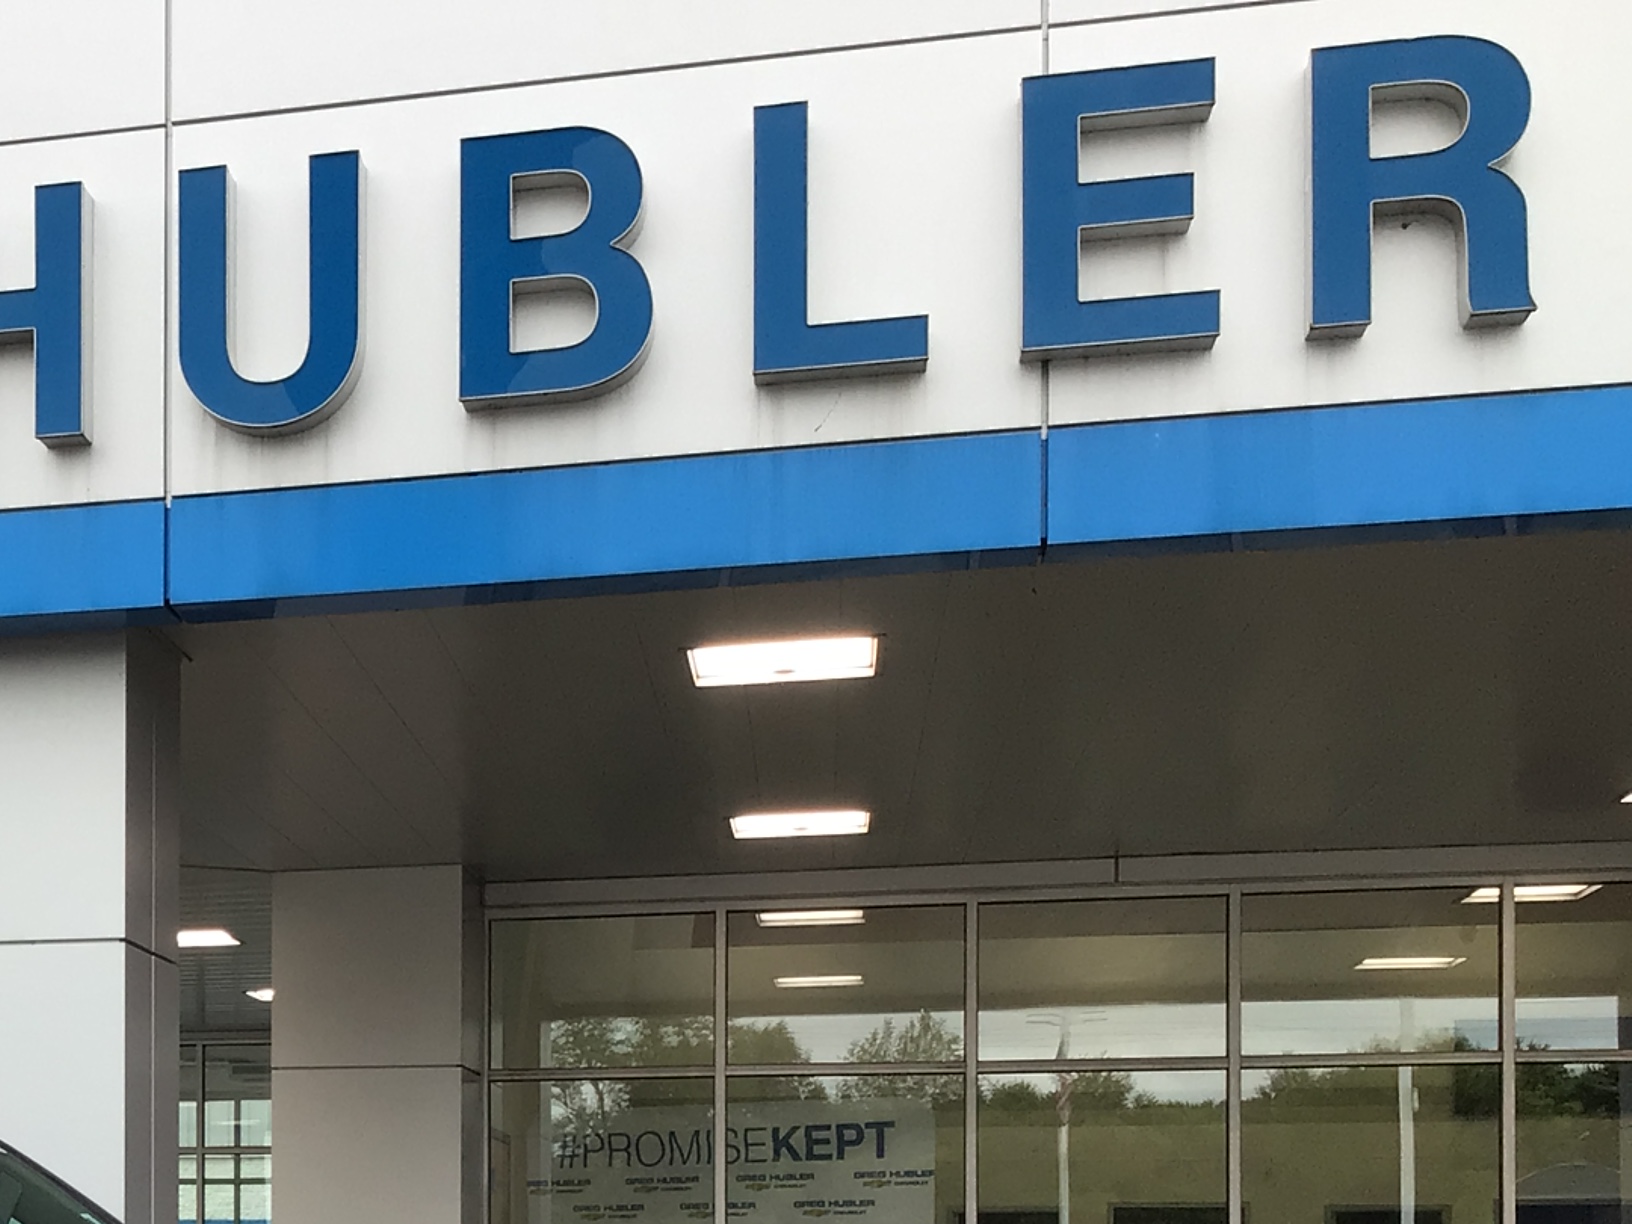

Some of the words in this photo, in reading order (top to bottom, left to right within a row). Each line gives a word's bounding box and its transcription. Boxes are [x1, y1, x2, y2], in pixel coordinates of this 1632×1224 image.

[557, 1120, 896, 1170] #PROMISEKEPT
[736, 1174, 766, 1182] GREG
[770, 1173, 814, 1181] HUBLER
[854, 1171, 886, 1179] GREG
[727, 1202, 756, 1211] BLER
[794, 1200, 825, 1208] GREG
[829, 1200, 875, 1208] HUBLER
